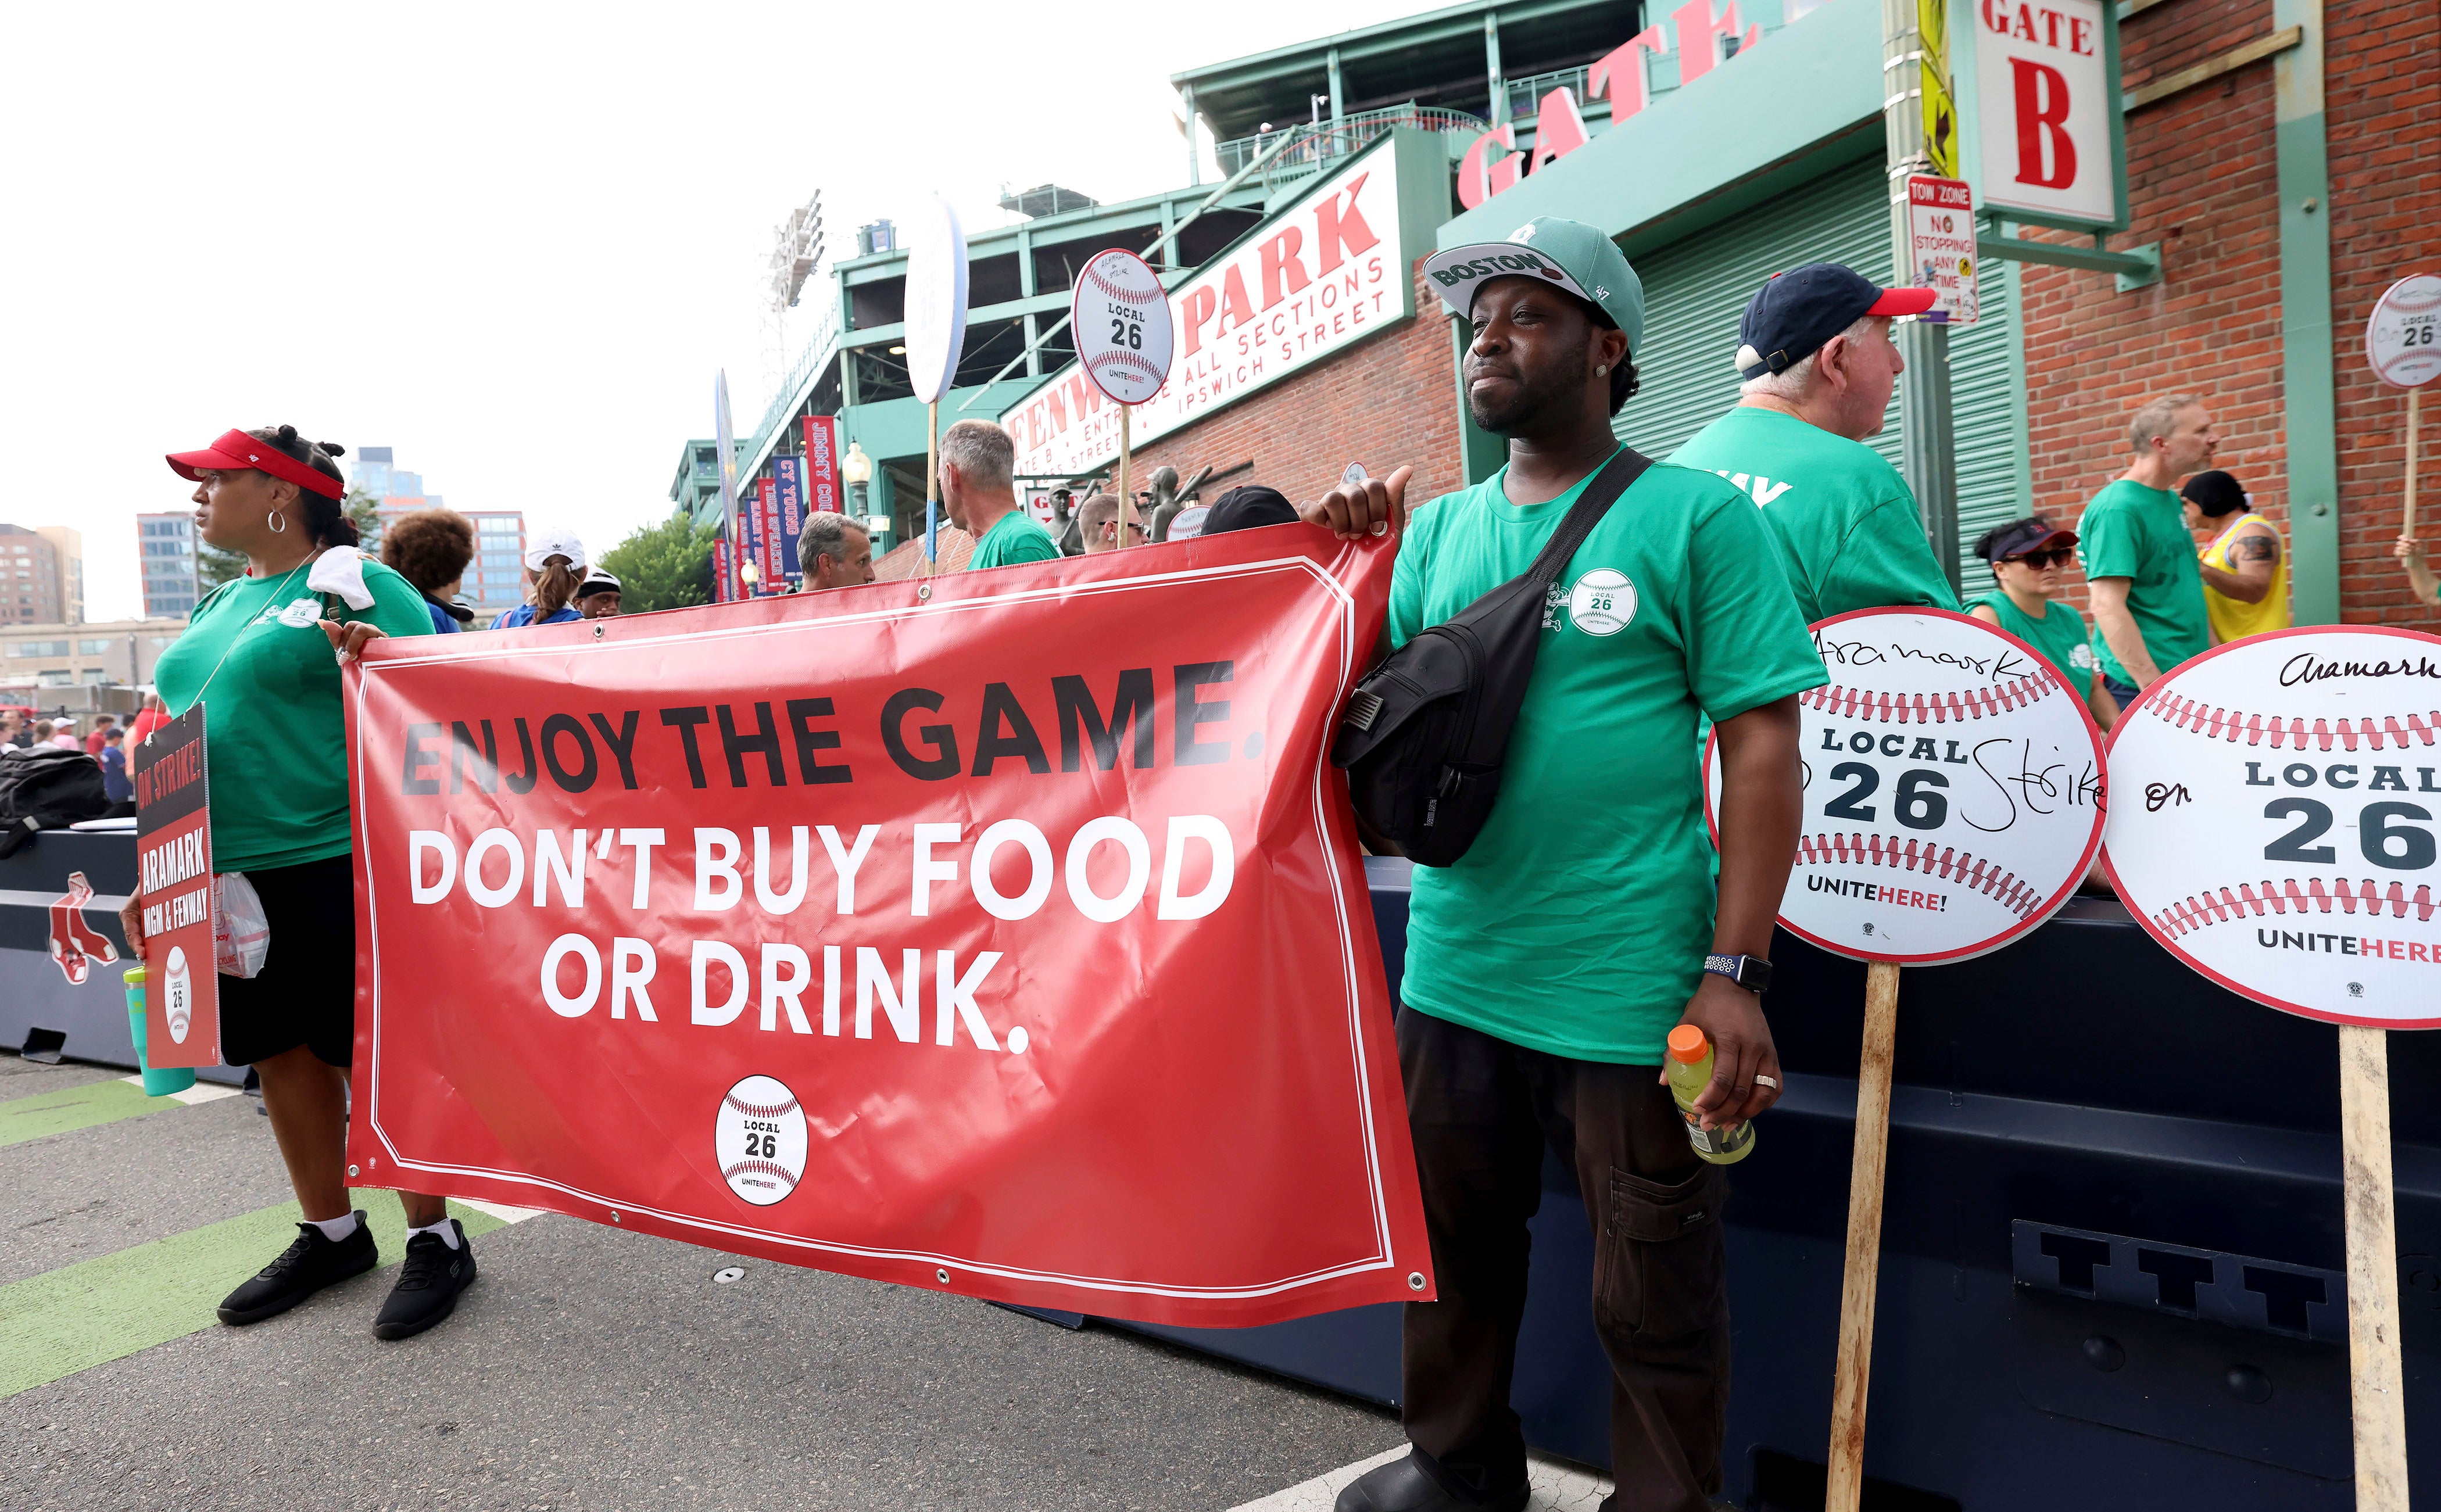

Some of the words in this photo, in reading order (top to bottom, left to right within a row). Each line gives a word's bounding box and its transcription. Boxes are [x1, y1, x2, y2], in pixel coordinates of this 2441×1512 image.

[1981, 0, 2094, 57] GATE
[1457, 0, 1759, 210] GATE
[2008, 56, 2077, 190] B
[1910, 182, 1935, 201] TOW
[1938, 185, 1970, 205] ZONE
[1916, 235, 1973, 253] STOPPING
[1931, 214, 1953, 234] NO
[1180, 171, 1381, 359] PARK
[1430, 253, 1548, 288] BOSTON
[1935, 256, 1956, 269] ANY
[1935, 274, 1960, 289] TIME
[1108, 303, 1145, 322] LOCAL
[1112, 318, 1141, 350] 26
[1185, 352, 1221, 386] ALL
[1239, 257, 1383, 356] SECTIONS
[1179, 356, 1263, 414] IPSWICH
[1283, 290, 1384, 360] STREET
[2404, 325, 2433, 347] 26
[781, 460, 794, 482] CY
[812, 422, 831, 481] JIMMY
[783, 485, 800, 536] YOUNG
[768, 516, 784, 576] SPEAKER
[1591, 598, 1612, 611] 26
[401, 710, 640, 796] ENJOY
[660, 697, 853, 789] THE
[880, 660, 1265, 782] GAME.
[1821, 728, 1968, 765] LOCAL
[138, 767, 152, 811] ON
[154, 737, 201, 802] STRIKE!
[1824, 761, 1950, 830] 26
[2245, 762, 2441, 793] LOCAL
[2264, 797, 2437, 870] 26
[143, 826, 206, 895] ARAMARK
[408, 827, 665, 910] DON'T
[693, 824, 882, 915] BUY
[911, 814, 1235, 923] FOOD
[144, 903, 164, 938] MGM
[165, 901, 171, 931] &
[173, 887, 207, 929] FENWAY
[1808, 875, 1947, 912] UNITEHERE!
[173, 990, 182, 1008] 26
[540, 933, 658, 1023] OR
[690, 940, 1029, 1055] DRINK.
[744, 1120, 780, 1133] LOCAL
[746, 1133, 776, 1159] 26
